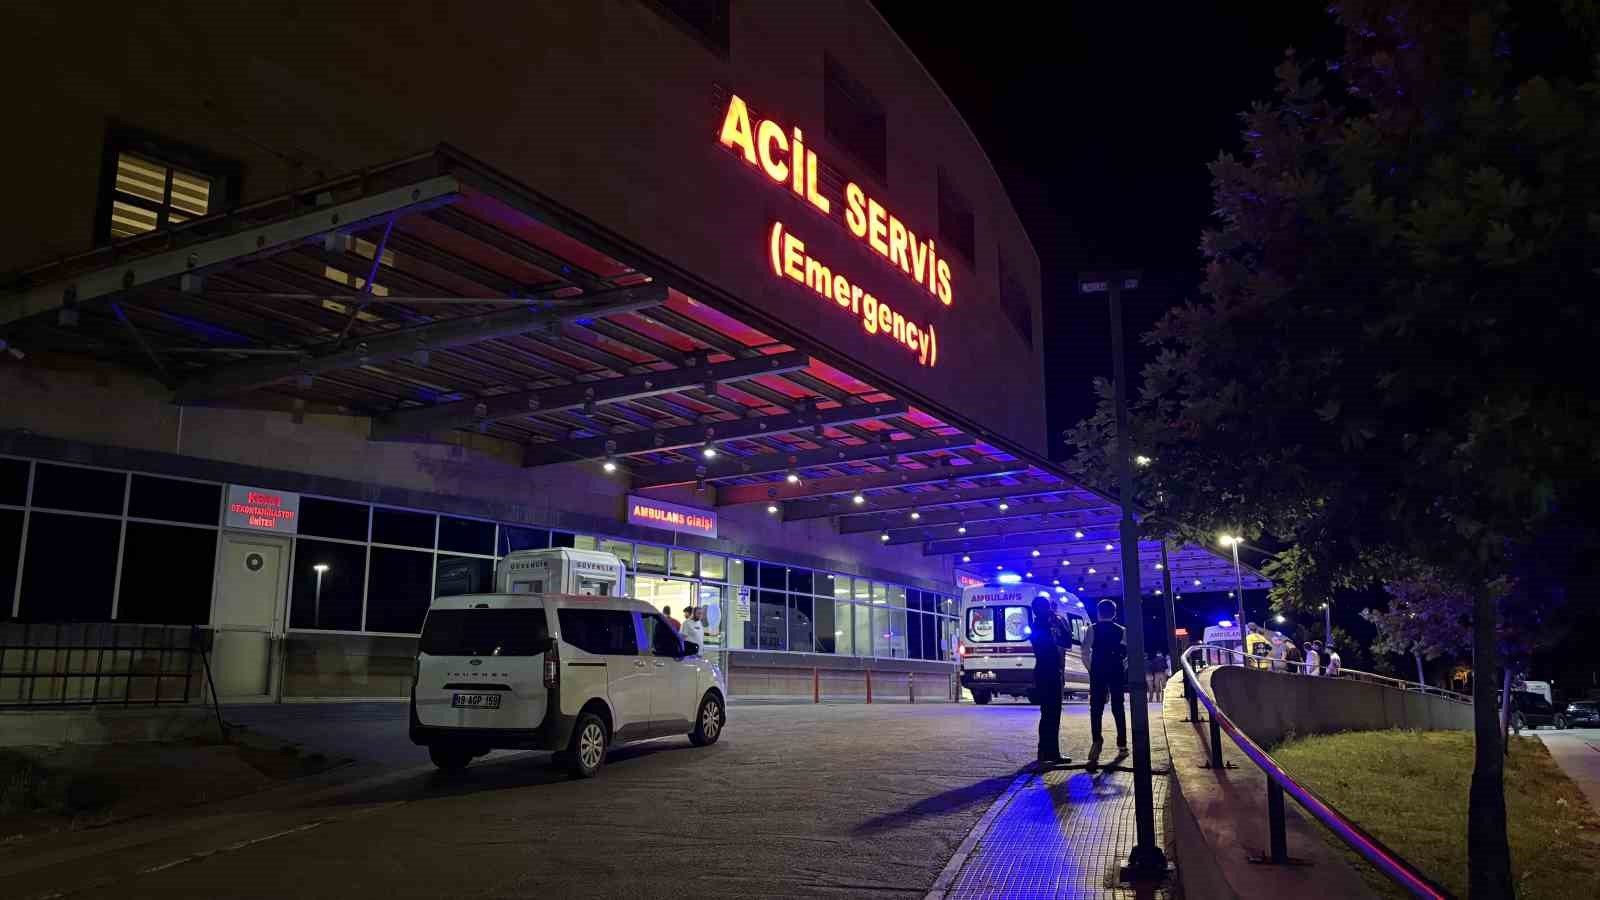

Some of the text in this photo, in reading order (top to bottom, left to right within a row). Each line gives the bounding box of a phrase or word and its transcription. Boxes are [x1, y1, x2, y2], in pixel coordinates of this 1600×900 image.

[719, 94, 953, 306] ACİL SERVİS
[770, 220, 937, 368] (Emergency)
[633, 504, 686, 525] AMBULANS
[971, 592, 1022, 602] AMBULANS
[1208, 631, 1241, 639] AMBULAN
